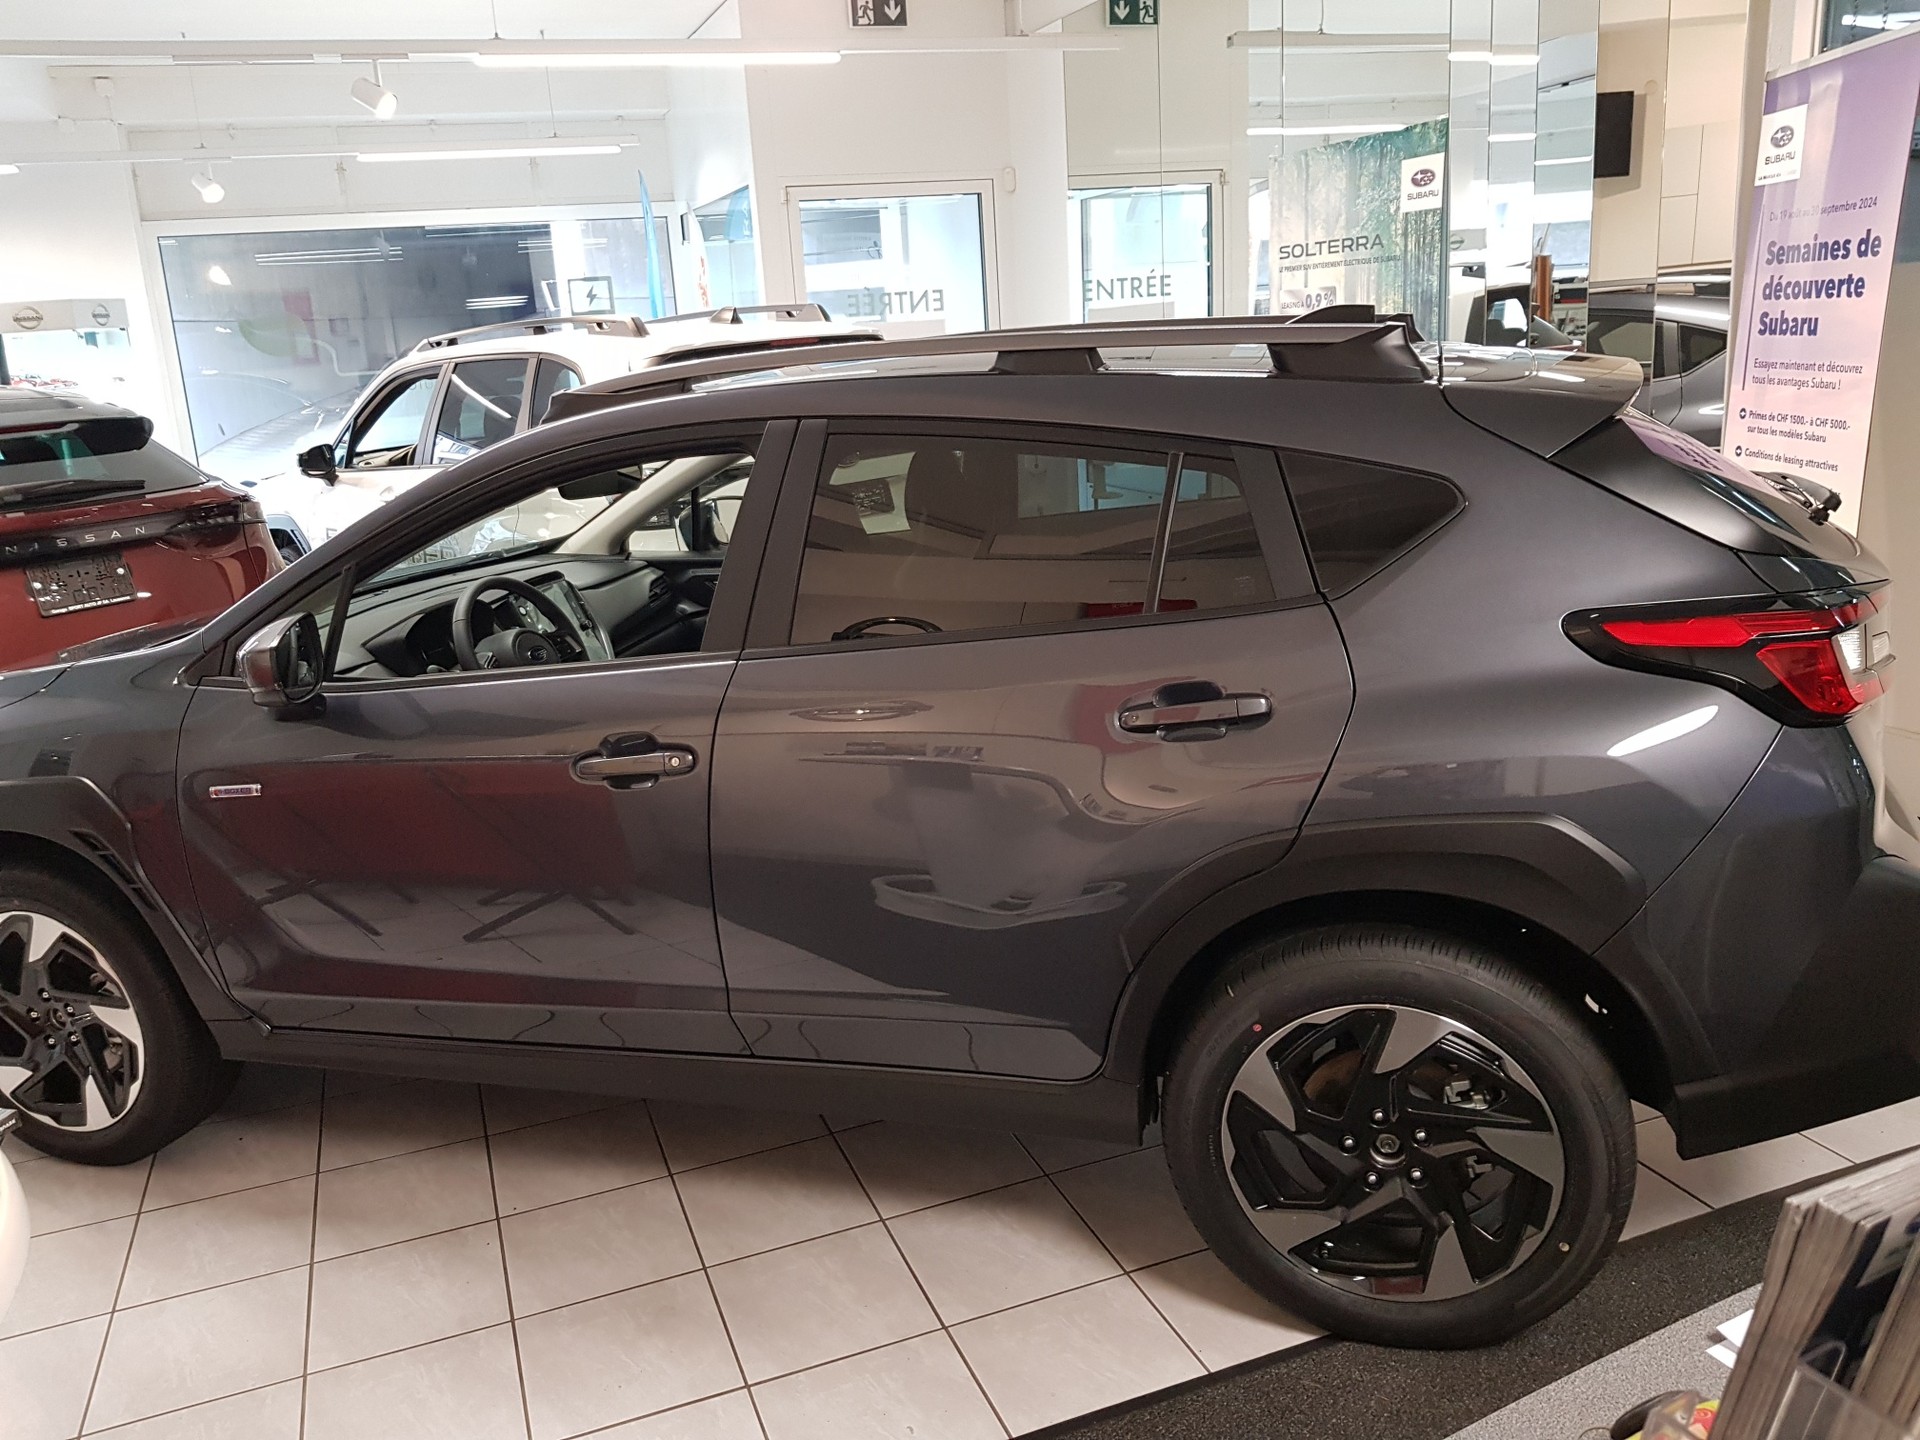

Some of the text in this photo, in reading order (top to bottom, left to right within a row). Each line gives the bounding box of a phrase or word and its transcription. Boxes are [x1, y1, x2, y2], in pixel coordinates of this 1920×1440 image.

[1764, 151, 1796, 166] SUBARU
[1406, 188, 1440, 201] SUBARU
[1820, 201, 1858, 217] septembre
[1859, 196, 1879, 210] 2024
[1279, 233, 1385, 260] SOLTERRA
[1765, 228, 1882, 266] Semaines de
[1082, 268, 1172, 302] ENTRÉE
[1762, 273, 1866, 301] découverte
[1757, 309, 1819, 337] Subaru
[1754, 358, 1863, 374] Essayez maintenant et découvrez
[1752, 375, 1766, 385] tous
[1767, 374, 1776, 385] les
[1776, 377, 1810, 390] avantages
[1810, 377, 1837, 390] Subaru
[1749, 410, 1767, 421] Primes
[1768, 412, 1775, 422] de
[1776, 413, 1789, 423] CHF
[1790, 415, 1809, 426] 1500.-
[1815, 417, 1829, 428] CHF
[1830, 419, 1851, 431] 5000.-
[1747, 425, 1827, 443] sur tous les modèles Subaru
[1744, 448, 1838, 472] Conditions de leasing attractives
